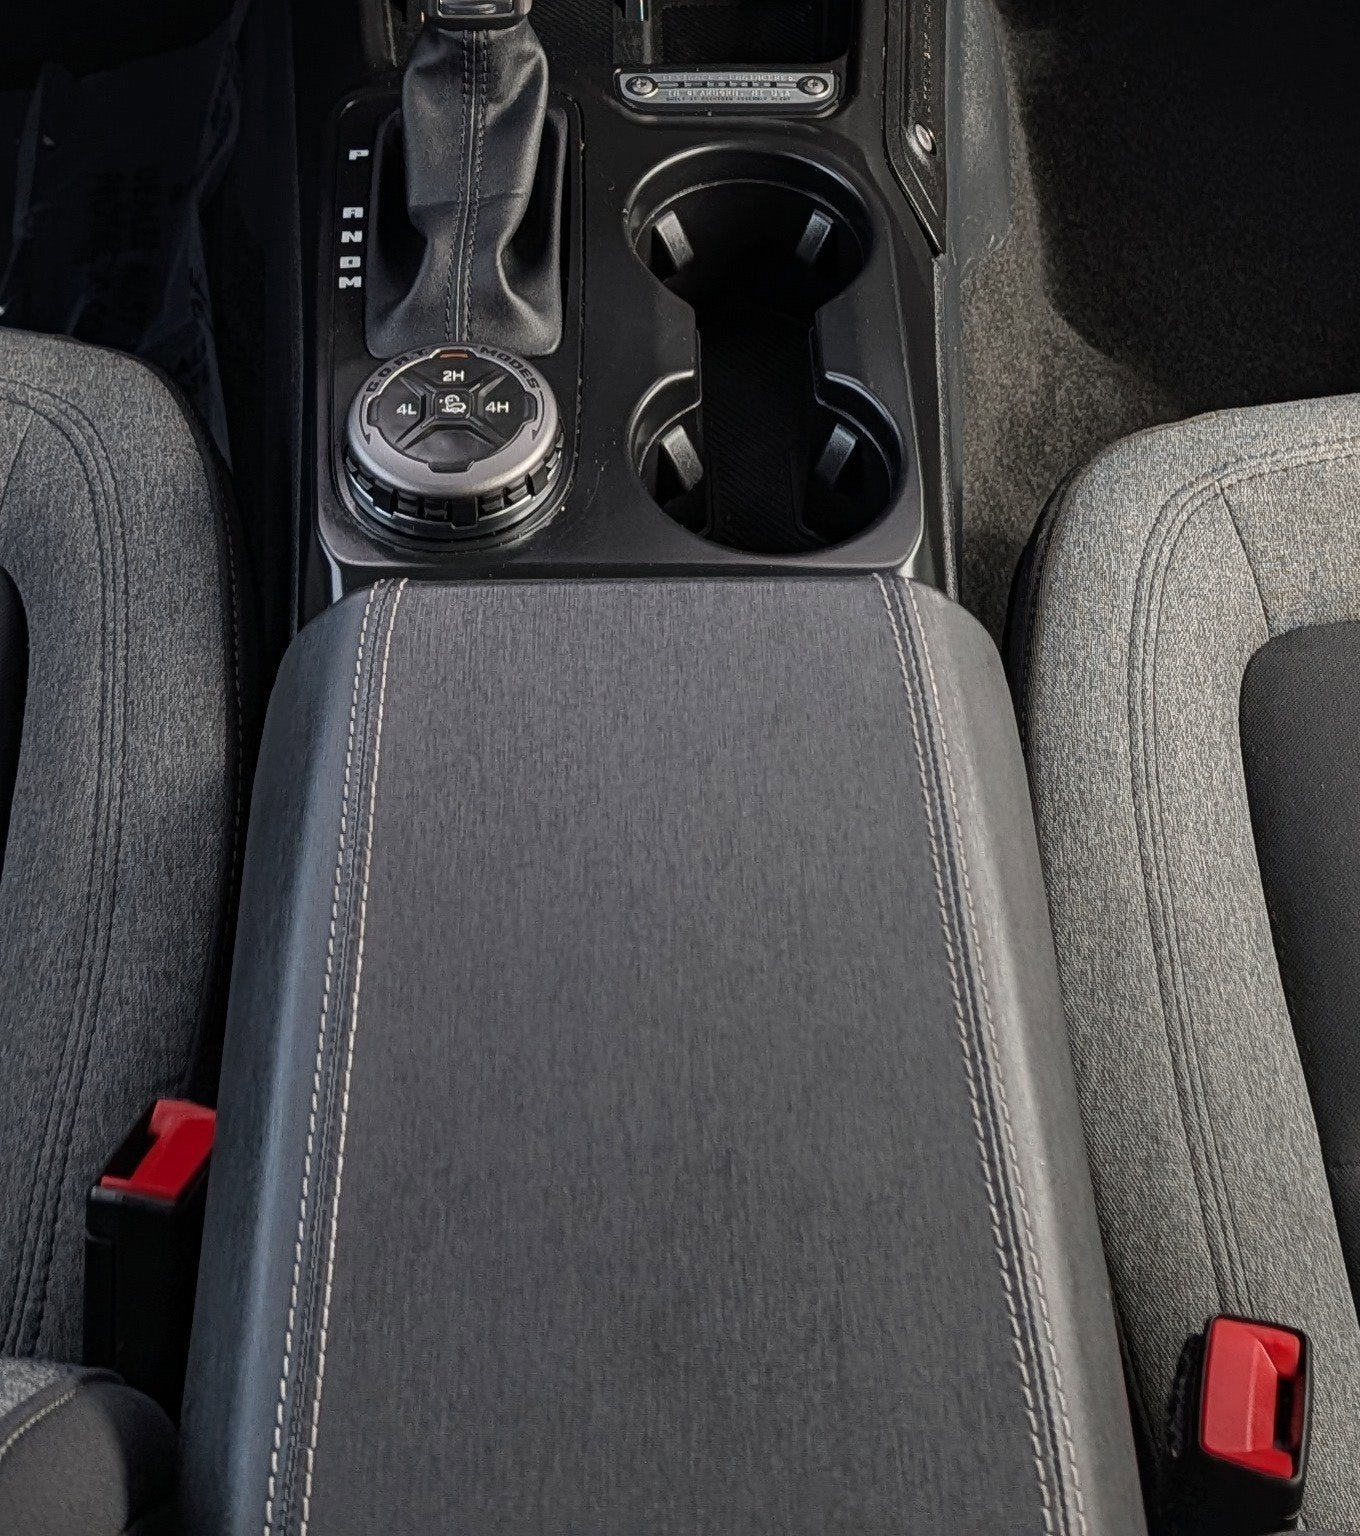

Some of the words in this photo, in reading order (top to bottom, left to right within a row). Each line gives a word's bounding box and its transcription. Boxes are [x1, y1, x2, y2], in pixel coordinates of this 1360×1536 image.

[349, 149, 369, 161] P
[341, 230, 362, 243] N
[339, 276, 362, 289] M
[479, 346, 540, 389] MODES
[442, 370, 465, 382] 2H
[396, 403, 417, 415] 4L
[485, 401, 509, 413] 4H
